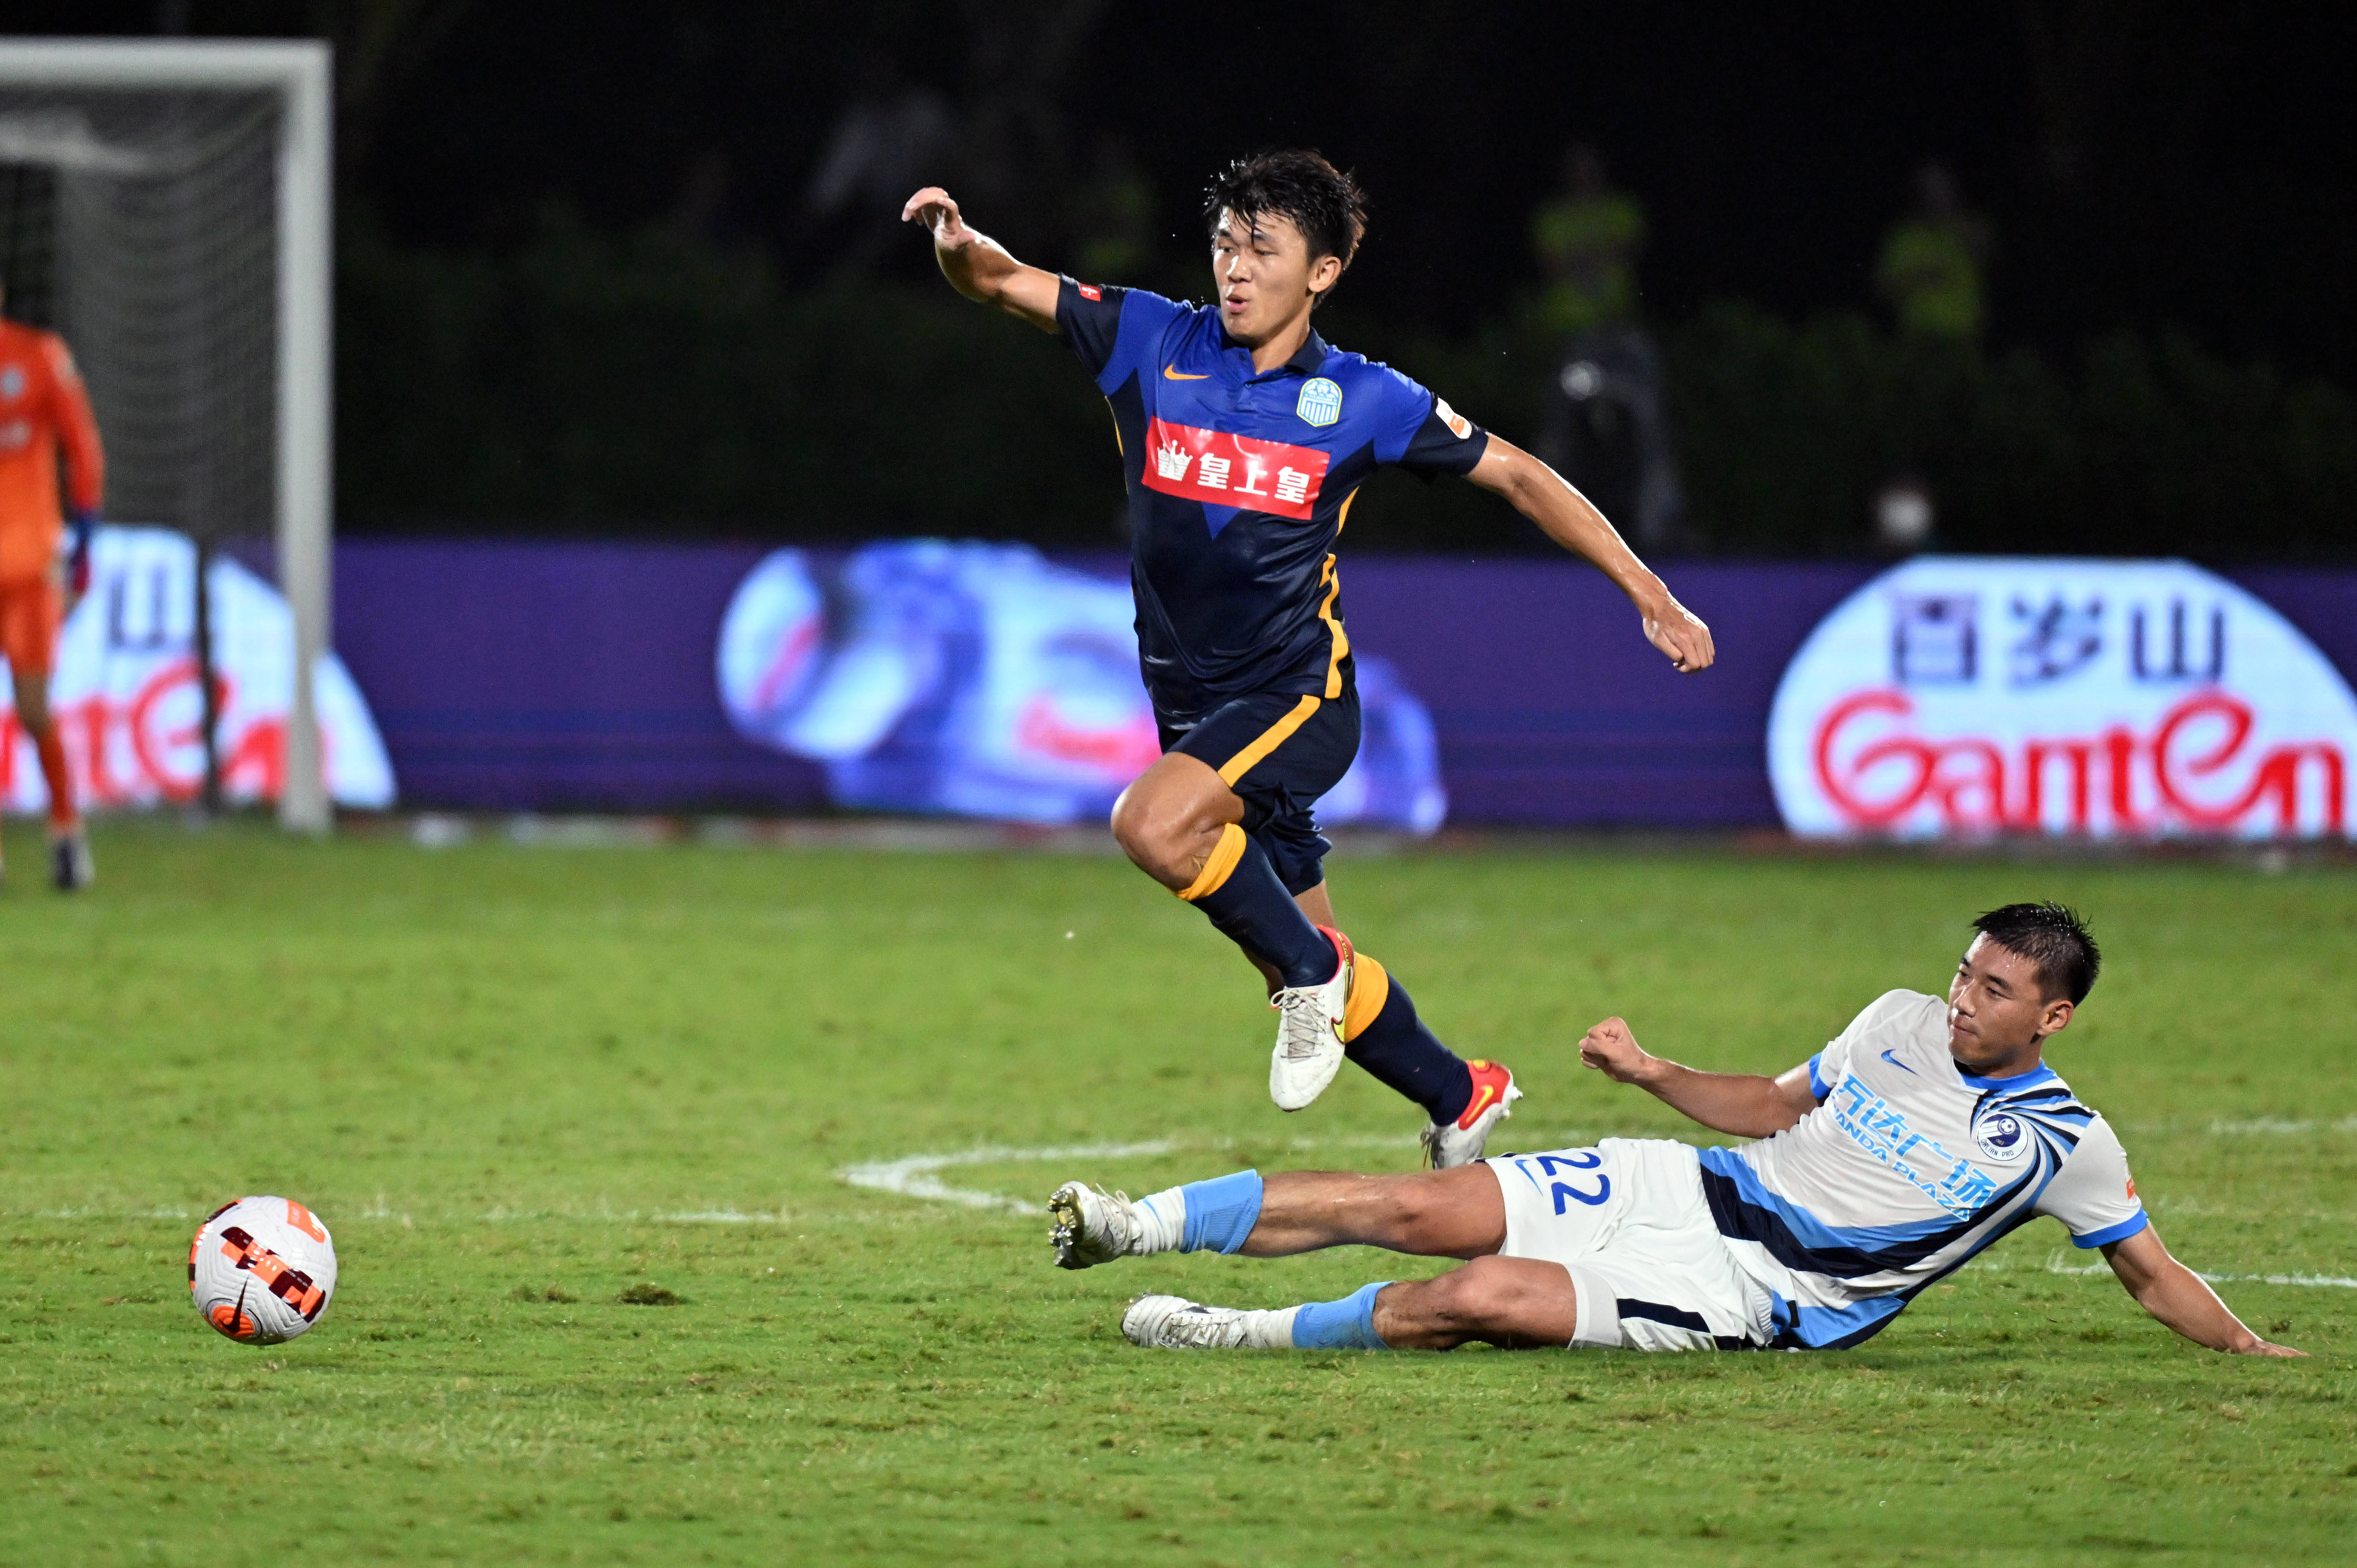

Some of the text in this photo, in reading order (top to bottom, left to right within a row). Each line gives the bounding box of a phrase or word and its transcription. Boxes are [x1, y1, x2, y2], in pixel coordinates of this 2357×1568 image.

[1197, 452, 1310, 504] 皇上皇
[1832, 1072, 1997, 1208] 万达广场
[1981, 1139, 1998, 1156] DALIAN
[1536, 1152, 1610, 1215] 22
[1893, 1161, 1969, 1221] PLAZA
